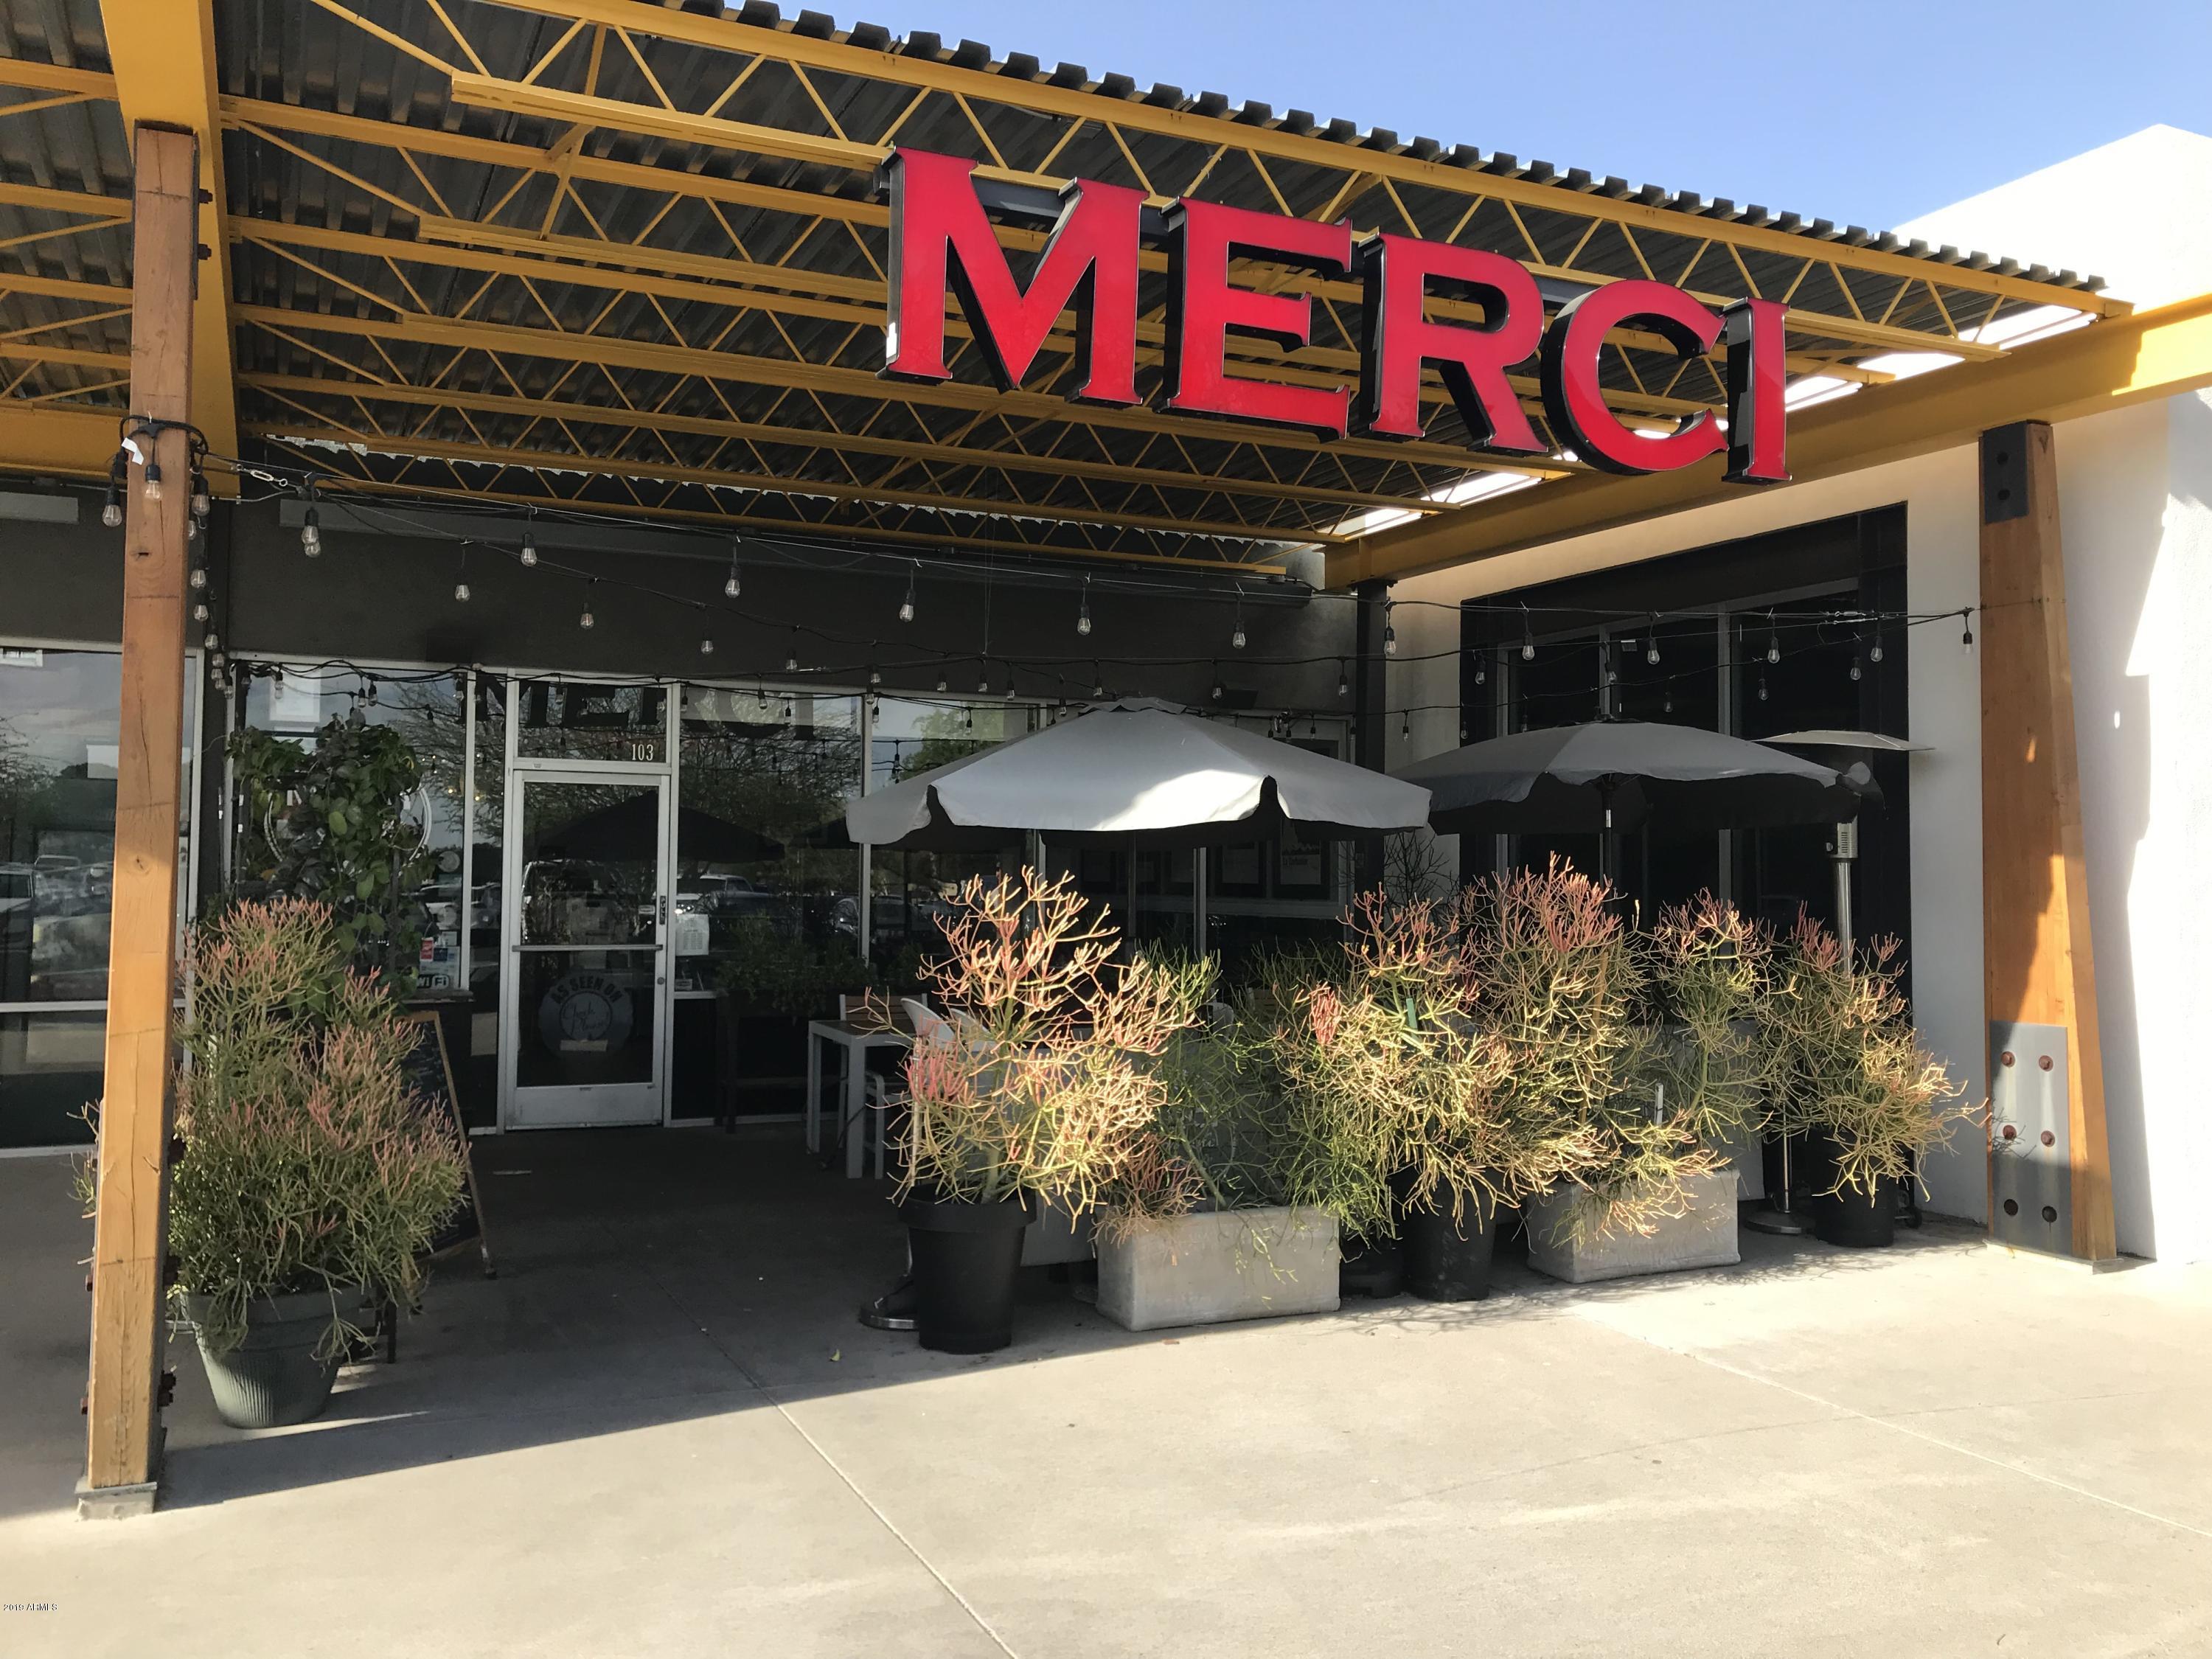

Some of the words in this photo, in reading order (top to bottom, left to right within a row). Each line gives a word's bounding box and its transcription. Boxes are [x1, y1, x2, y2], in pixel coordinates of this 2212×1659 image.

[883, 146, 1792, 483] MERCI
[632, 743, 654, 761] 103
[552, 985, 569, 1004] AS
[569, 975, 604, 992] SEEN
[604, 984, 622, 1003] ON
